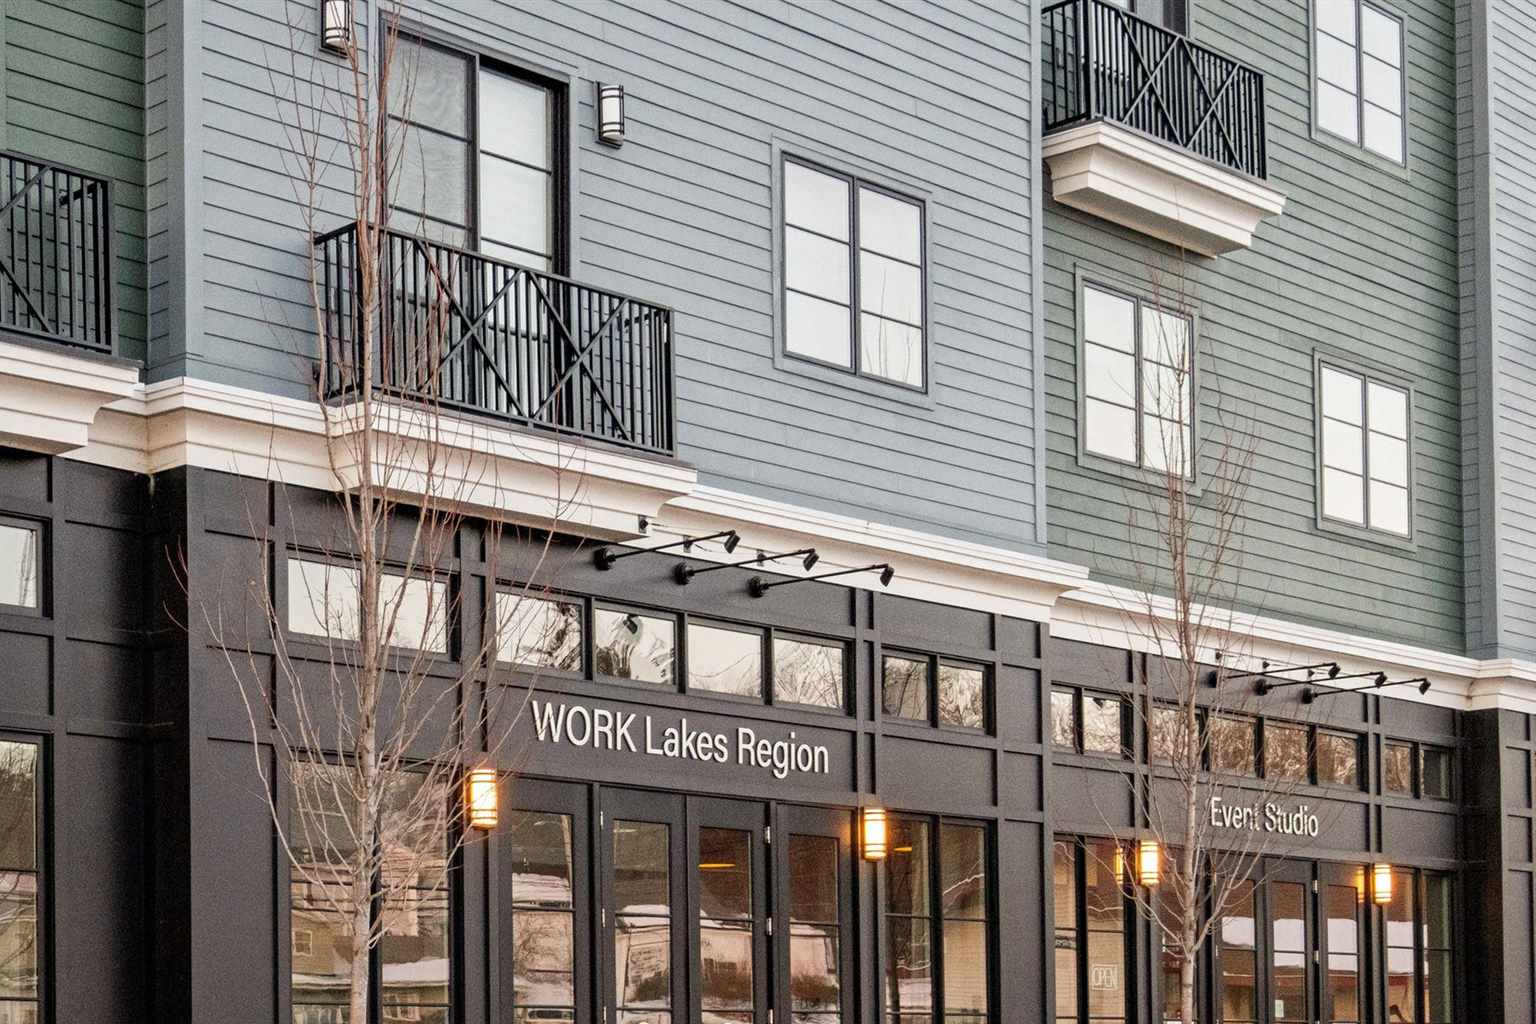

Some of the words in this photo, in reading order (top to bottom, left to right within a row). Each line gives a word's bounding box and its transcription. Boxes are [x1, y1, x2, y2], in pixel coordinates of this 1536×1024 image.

[532, 700, 637, 752] WORK
[645, 715, 729, 763] Lakes
[737, 727, 829, 779] Region
[1265, 803, 1319, 837] Studio
